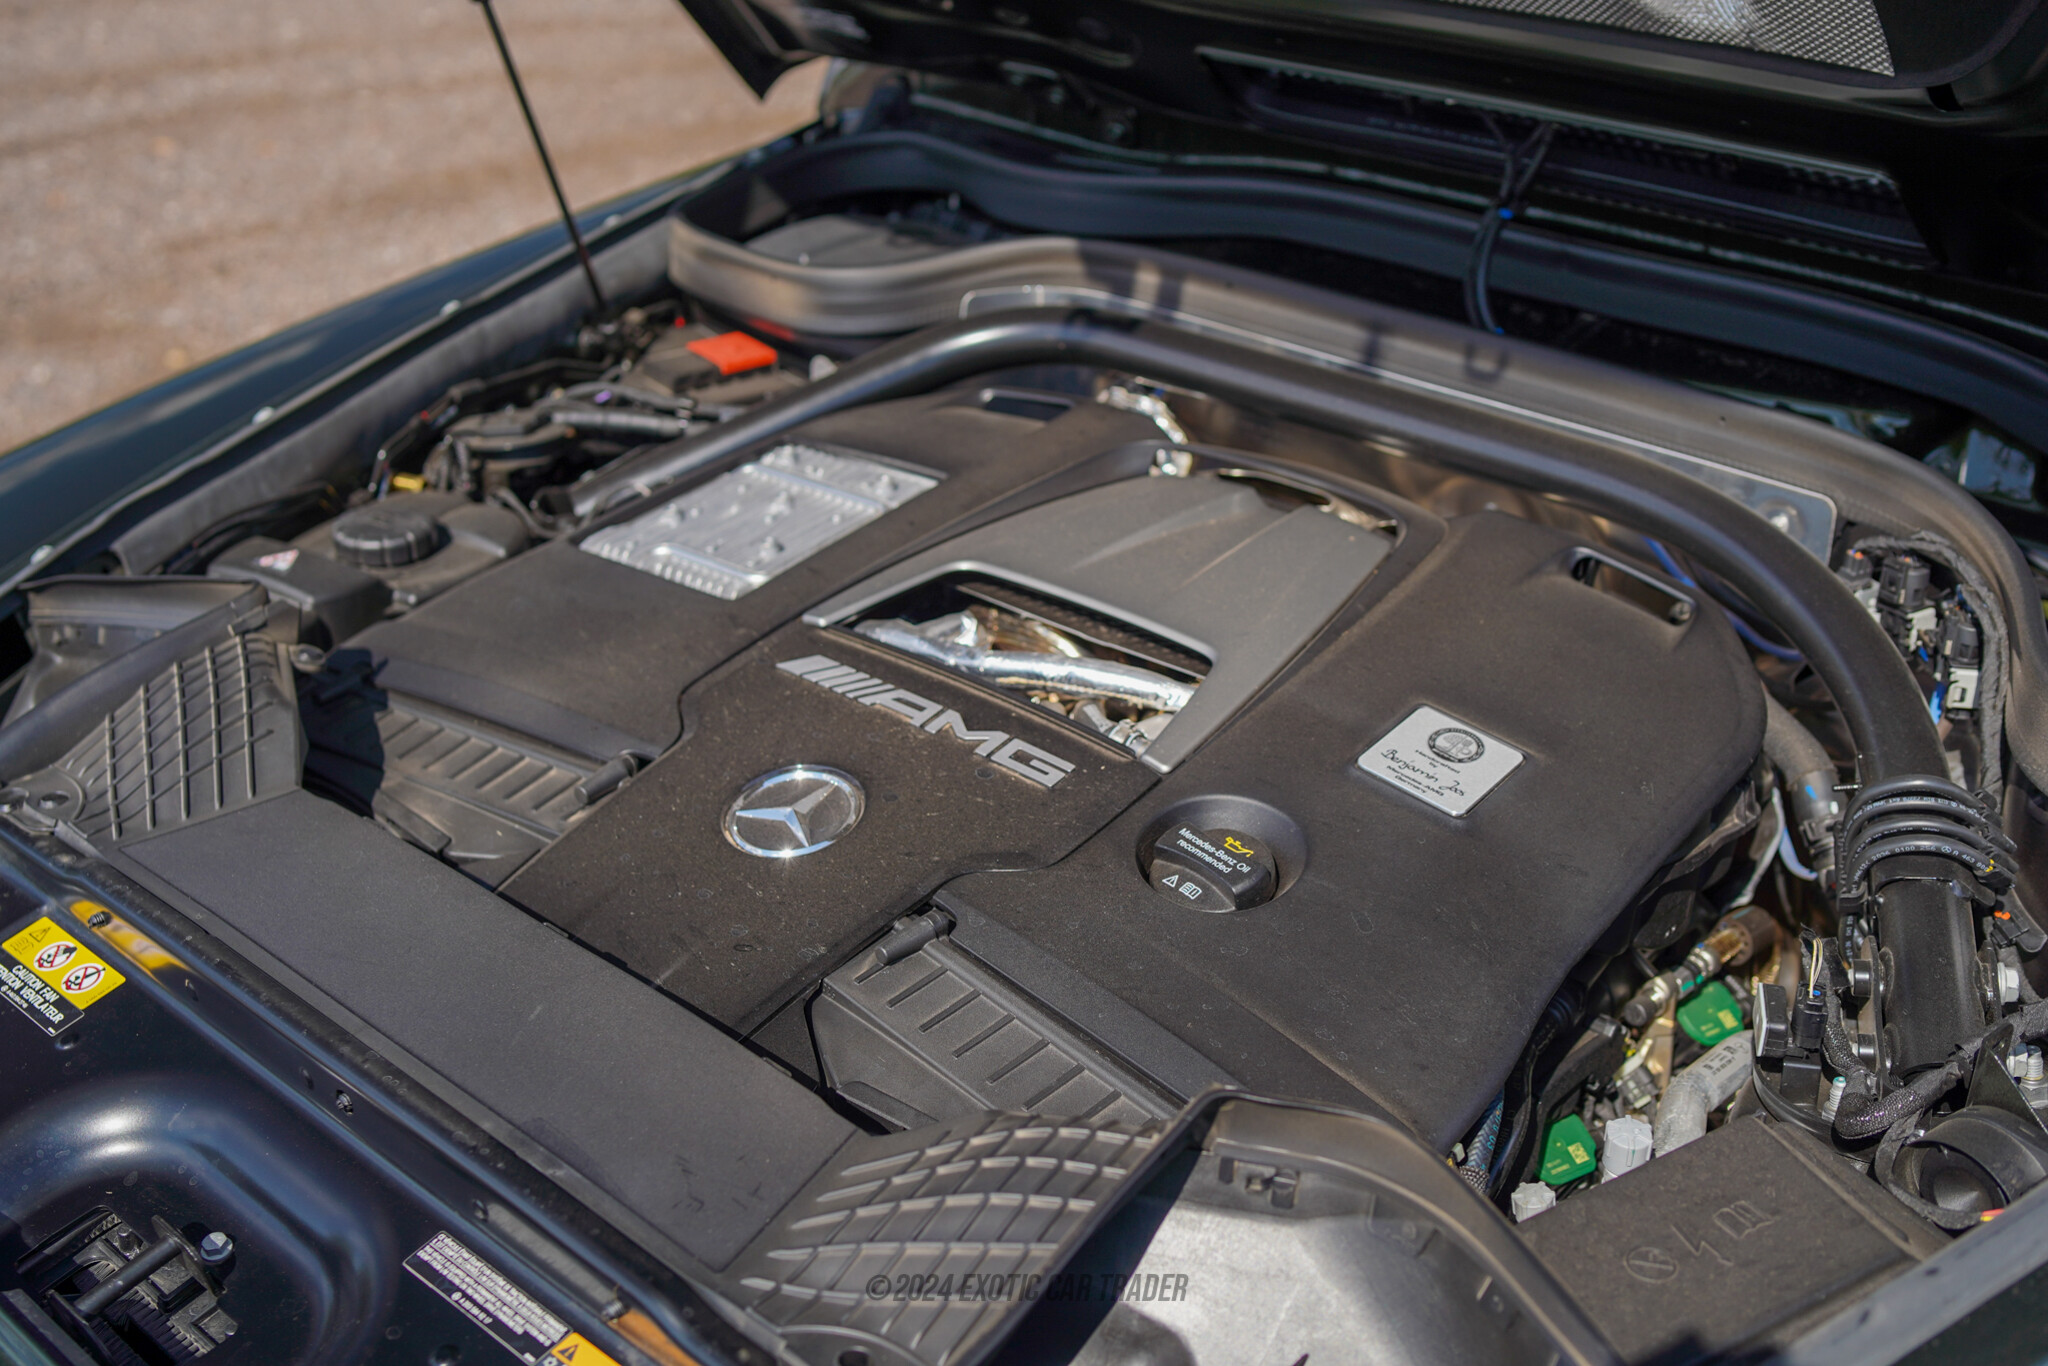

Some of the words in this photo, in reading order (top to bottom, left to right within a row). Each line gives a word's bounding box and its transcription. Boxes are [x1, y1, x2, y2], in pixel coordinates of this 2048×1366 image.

[857, 688, 1076, 788] AMG
[1176, 838, 1233, 874] recommended
[1178, 827, 1238, 867] Mercedes-Benz
[1236, 862, 1252, 874] Oil
[12, 964, 46, 991] CAUTION
[39, 986, 60, 1003] FAN
[20, 985, 65, 1025] VENTILATEUR
